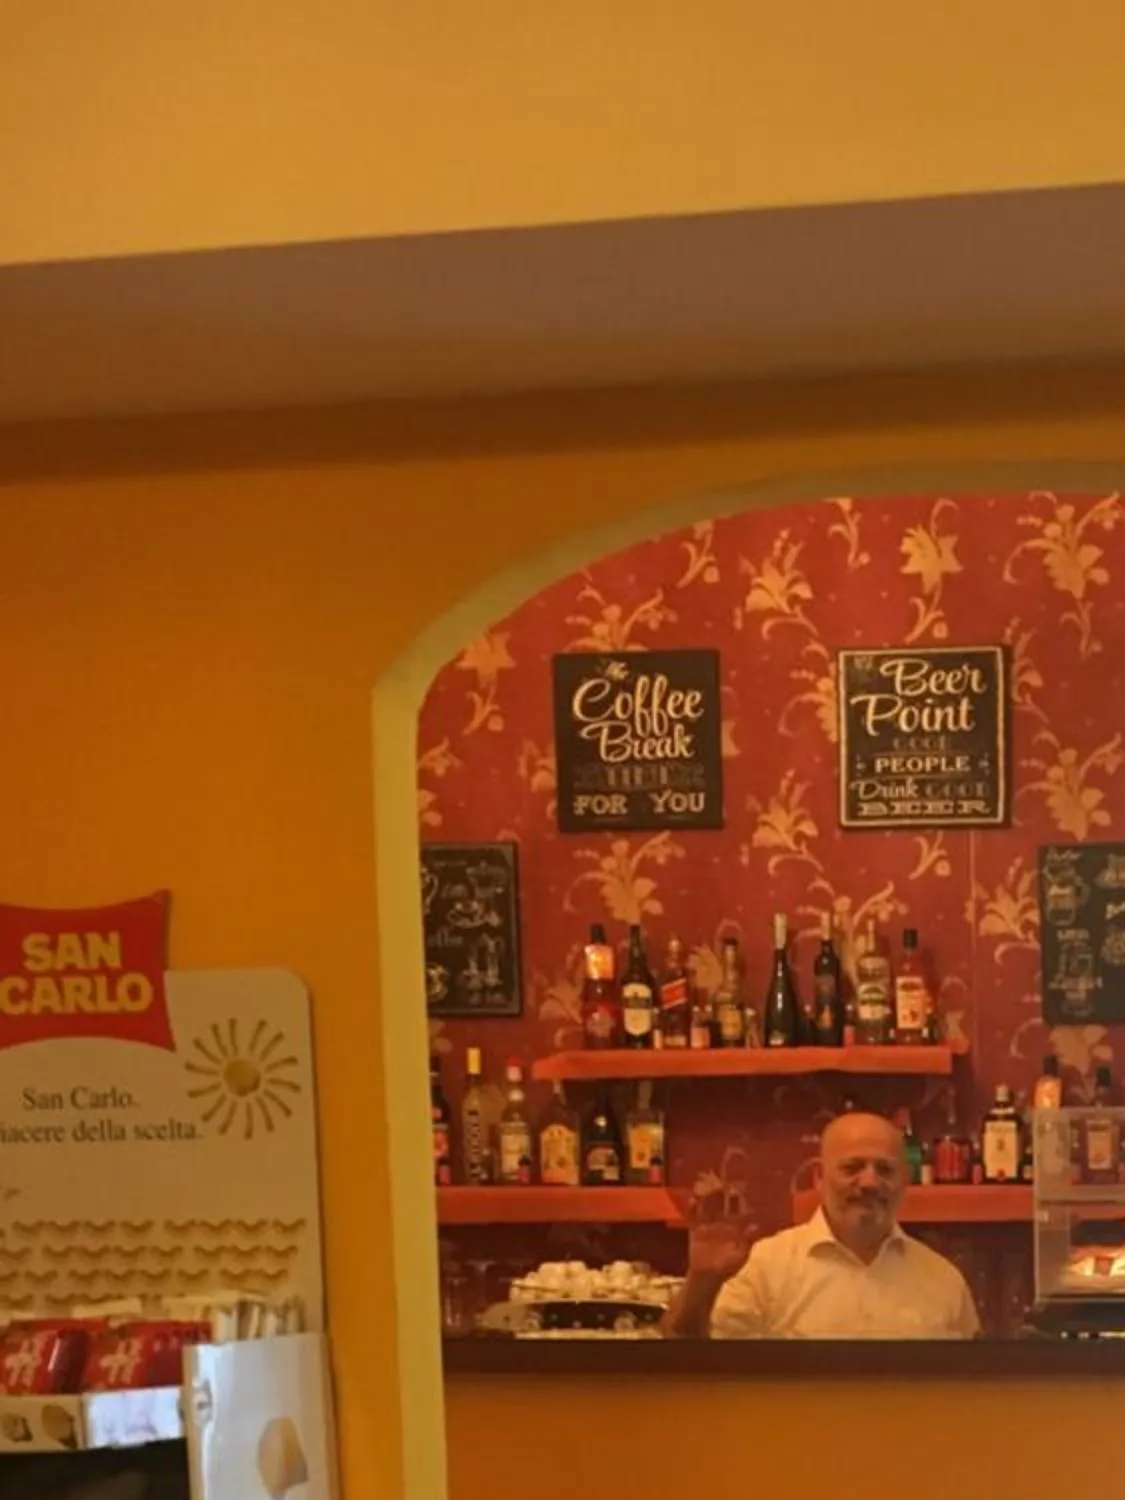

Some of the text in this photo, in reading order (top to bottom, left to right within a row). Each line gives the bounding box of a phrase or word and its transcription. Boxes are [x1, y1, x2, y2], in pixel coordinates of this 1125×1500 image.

[879, 657, 988, 697] Beer
[572, 672, 705, 738] Coffee
[850, 693, 976, 737] Point
[579, 719, 695, 763] Break
[874, 755, 972, 774] PEOPLE
[573, 789, 706, 816] FOR YOU
[850, 776, 919, 800] Drink
[857, 800, 991, 817] BEER
[22, 931, 122, 972] SAN
[0, 972, 154, 1015] CARLO
[22, 1086, 64, 1110] San
[72, 1118, 126, 1142] della
